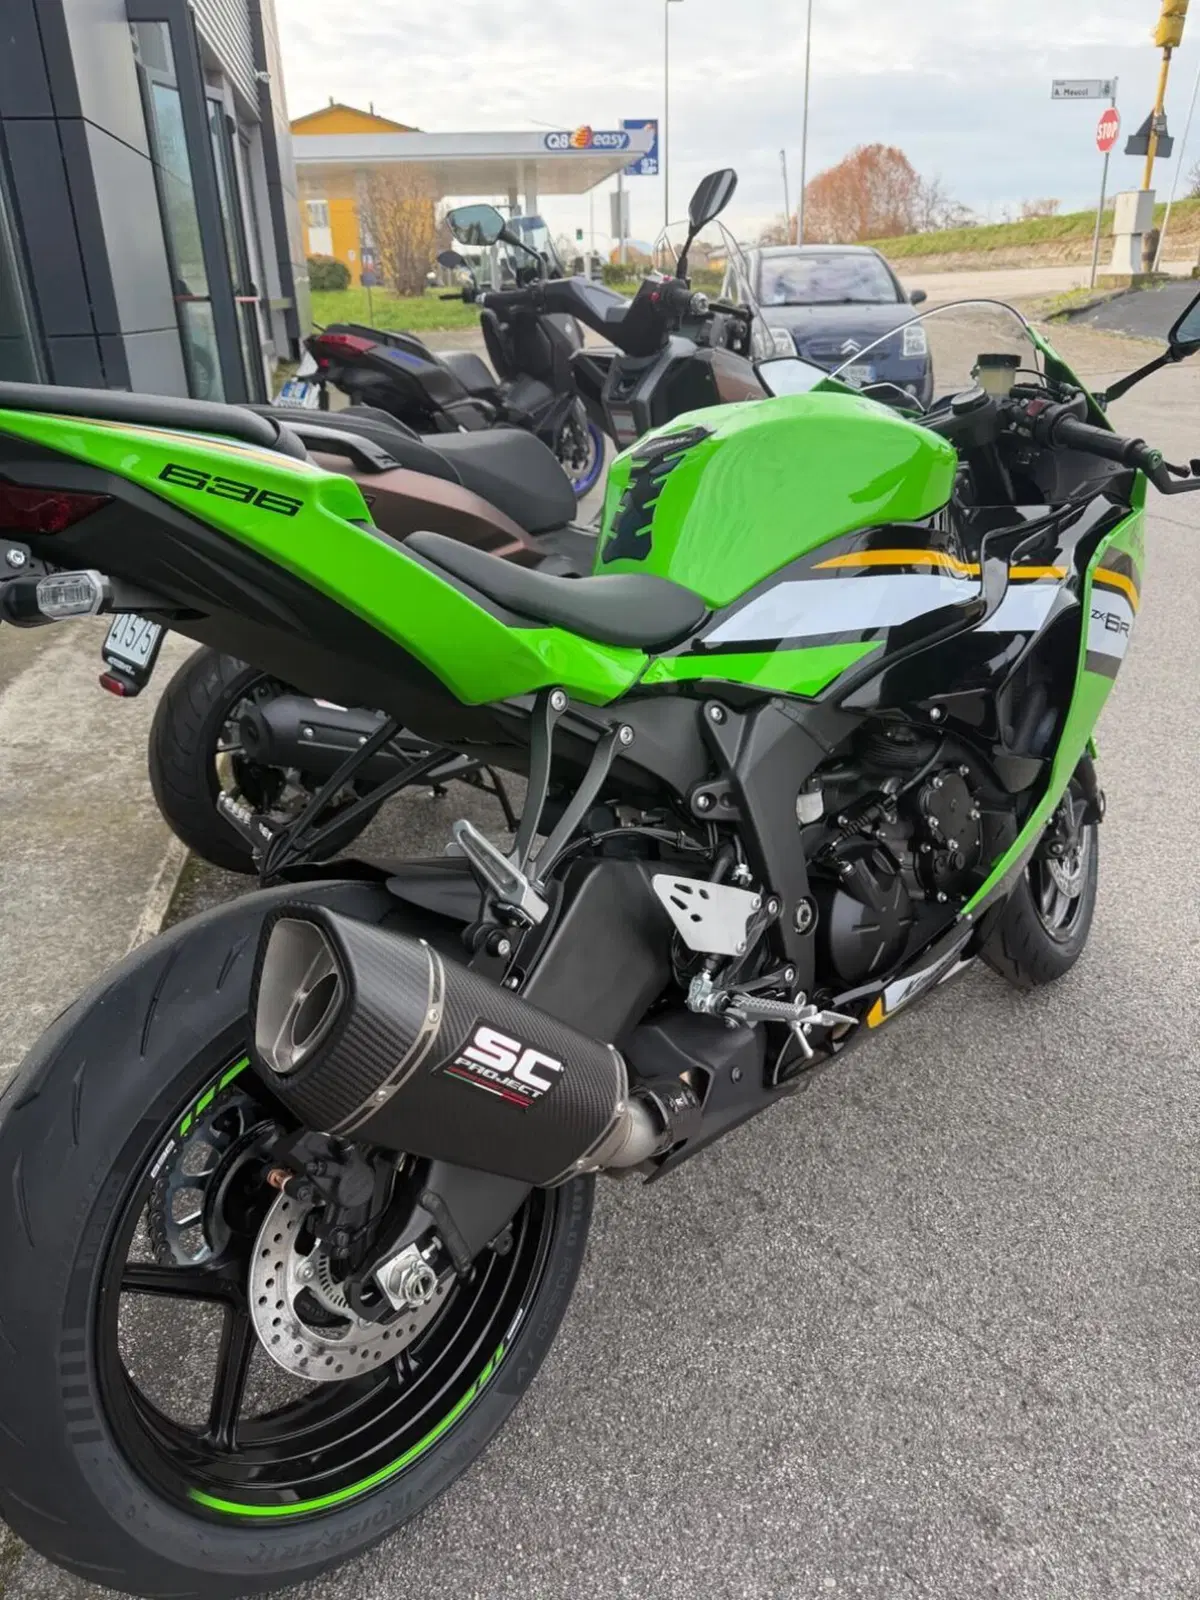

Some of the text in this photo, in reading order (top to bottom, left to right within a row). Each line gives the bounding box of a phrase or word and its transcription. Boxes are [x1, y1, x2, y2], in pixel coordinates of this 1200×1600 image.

[546, 133, 627, 149] Q8 easy
[1097, 121, 1118, 140] STOP
[158, 463, 305, 517] 636
[453, 1057, 544, 1099] PROJECT
[462, 1026, 562, 1092] SC
